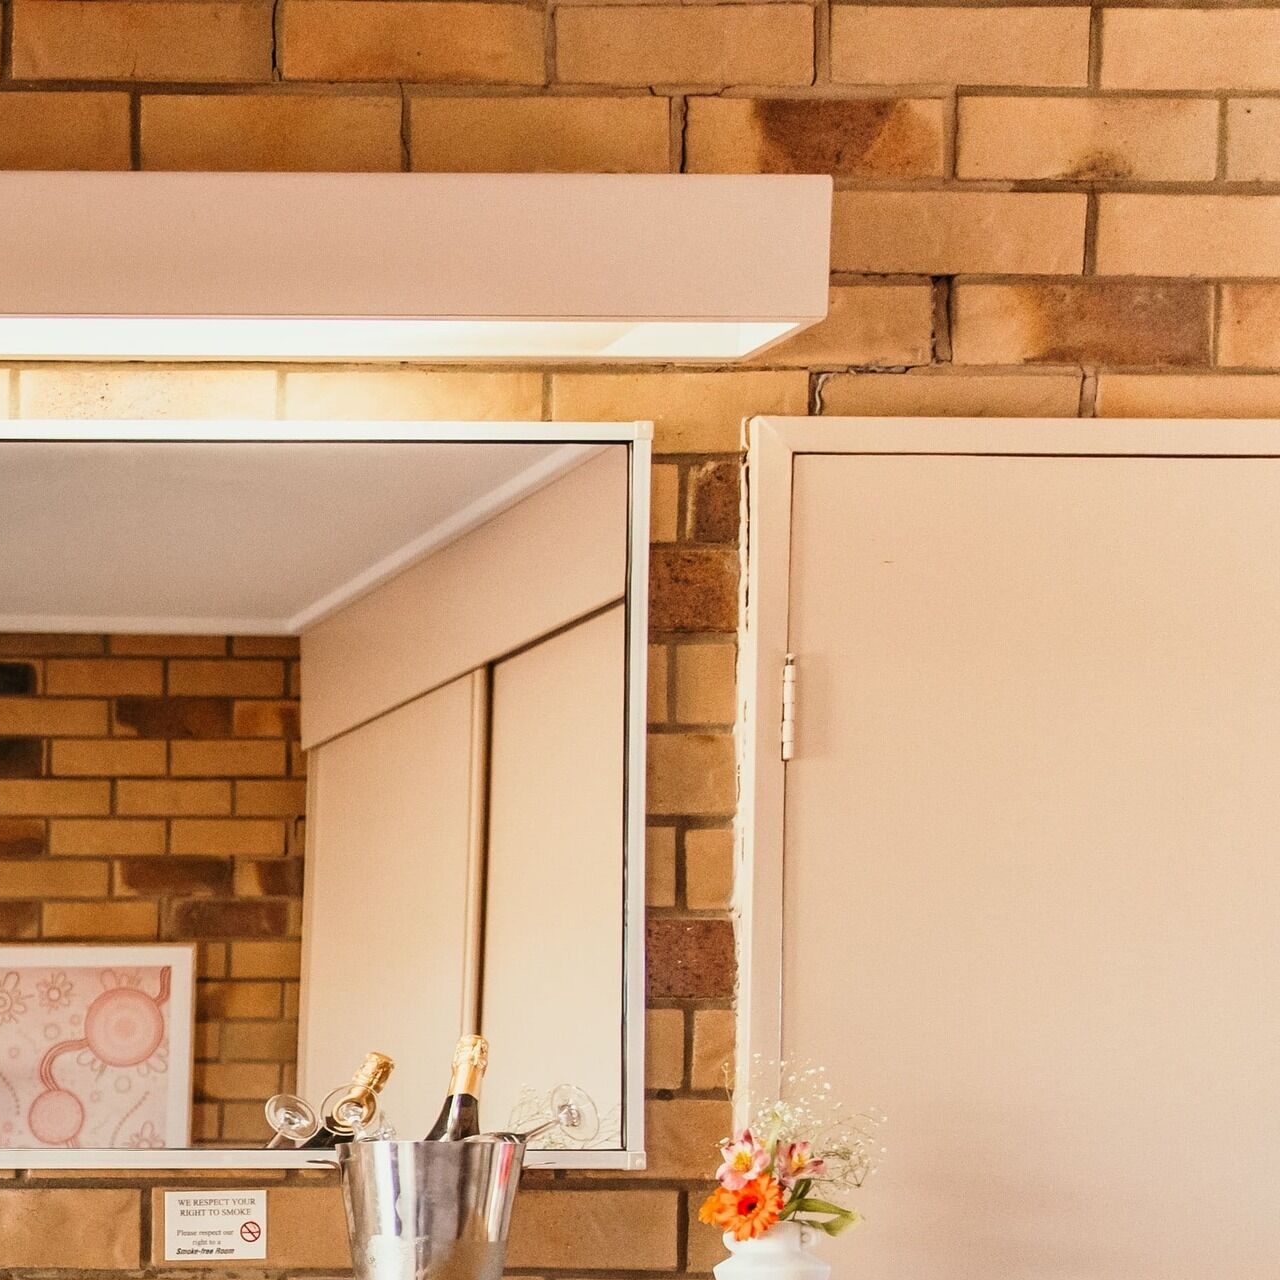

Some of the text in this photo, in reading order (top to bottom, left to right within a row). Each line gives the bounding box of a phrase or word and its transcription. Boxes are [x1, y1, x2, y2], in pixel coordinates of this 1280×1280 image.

[178, 1198, 256, 1207] WE RESPECT YOUR
[180, 1208, 251, 1217] RIGHT TO SMOKE
[176, 1229, 197, 1237] Please
[198, 1229, 221, 1238] respect
[192, 1238, 207, 1247] right
[176, 1247, 235, 1255] Smoke-free Room
